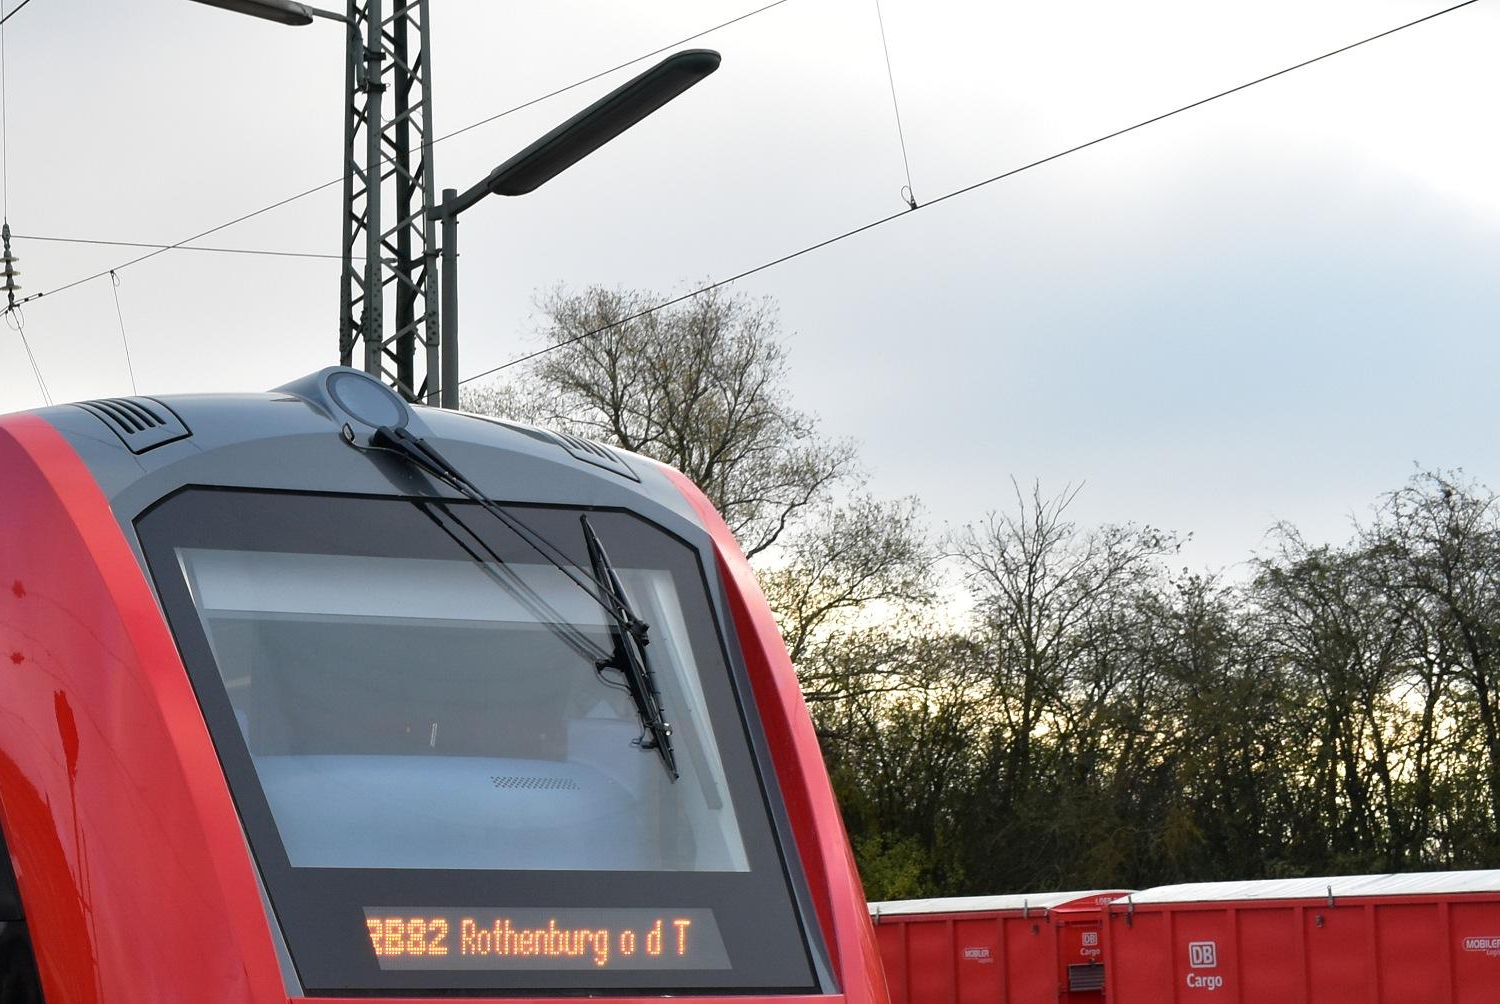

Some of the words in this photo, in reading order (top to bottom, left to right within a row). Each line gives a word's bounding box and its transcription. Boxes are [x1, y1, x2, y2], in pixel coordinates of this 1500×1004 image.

[461, 919, 608, 967] Rothenburg
[620, 930, 636, 955] o
[646, 919, 662, 955] d
[674, 919, 691, 955] T
[1080, 946, 1100, 957] Cargo
[1191, 945, 1214, 965] DB
[1187, 973, 1223, 991] Cargo
